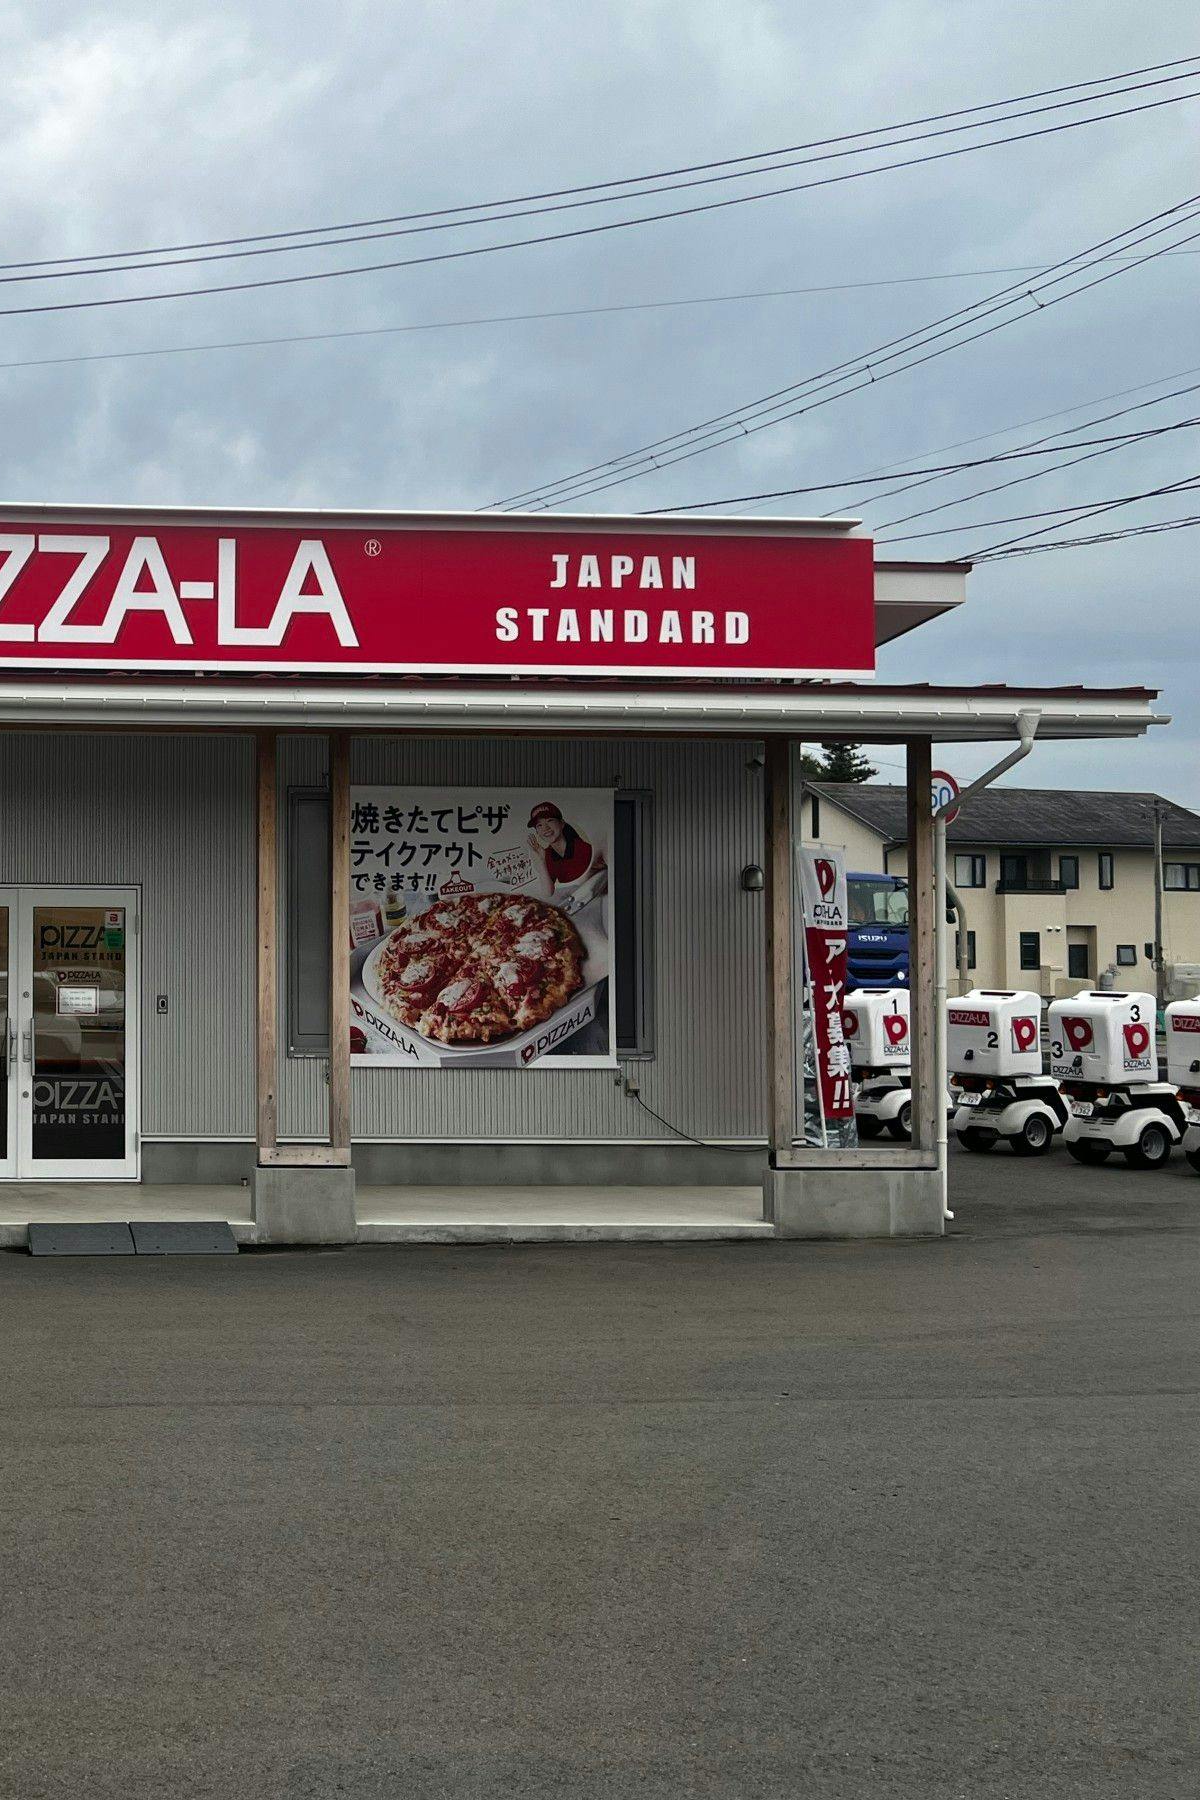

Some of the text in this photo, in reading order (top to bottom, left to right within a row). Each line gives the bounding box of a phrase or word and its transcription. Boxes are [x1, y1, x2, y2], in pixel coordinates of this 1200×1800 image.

[549, 554, 696, 590] JAPAN
[495, 607, 750, 645] STANDARD
[350, 802, 511, 835] 焼きたてピザ
[350, 840, 483, 868] テイクアウト
[441, 884, 474, 895] TAKEOUT
[891, 998, 898, 1015] 1
[1130, 1004, 1141, 1022] 3
[949, 1011, 989, 1024] PIZZA-LA
[986, 1031, 999, 1049] 2
[1051, 1040, 1064, 1059] 3
